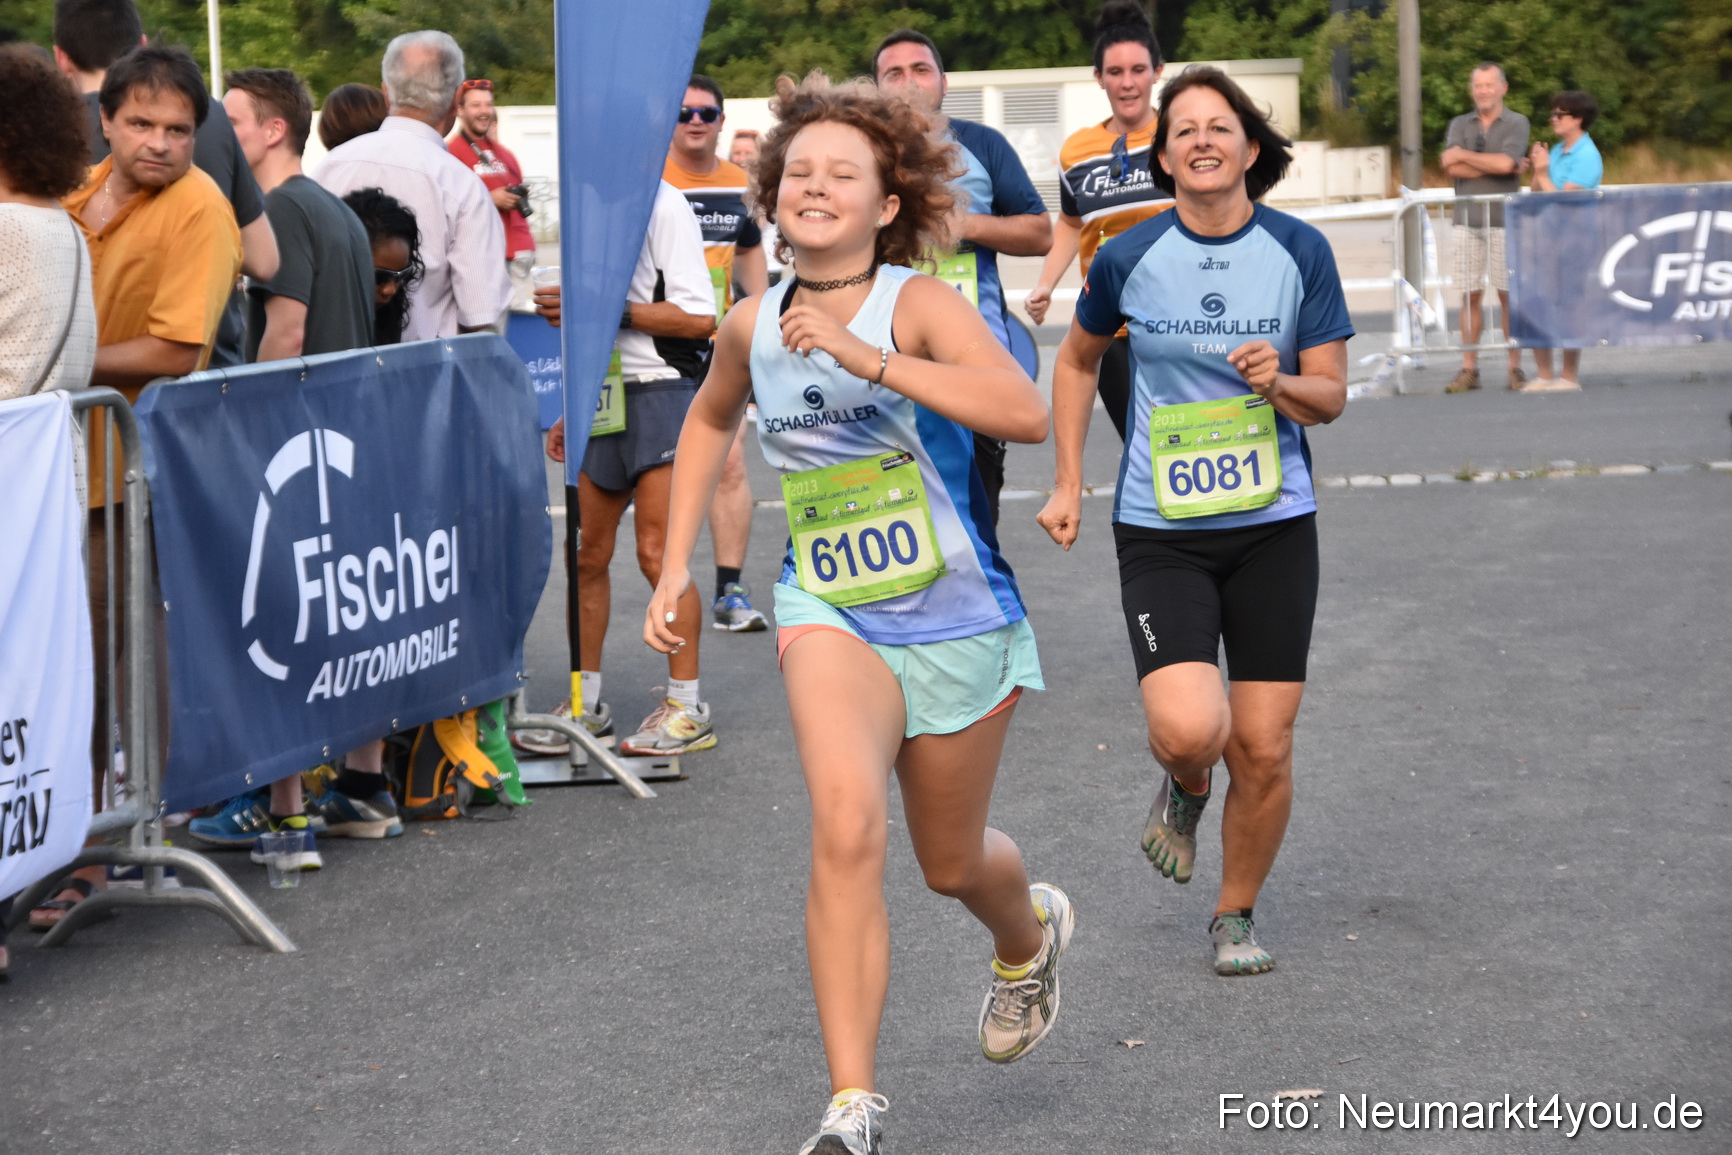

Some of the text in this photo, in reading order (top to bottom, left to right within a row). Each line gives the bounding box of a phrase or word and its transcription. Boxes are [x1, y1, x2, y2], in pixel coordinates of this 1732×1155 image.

[695, 211, 740, 225] scher
[1651, 251, 1732, 298] Fis
[1145, 318, 1281, 335] SCHABMÜLLER
[1672, 299, 1732, 322] AUT
[1192, 343, 1227, 354] TEAM
[765, 404, 880, 433] SCHABMÜLLER
[1154, 413, 1185, 427] 2013
[790, 479, 818, 496] 2013
[1168, 449, 1261, 496] 6081
[811, 519, 919, 582] 6100
[306, 617, 459, 703] AUTOMOBILE
[999, 647, 1010, 685] Reebok
[0, 717, 28, 766] er
[0, 773, 52, 860] räu
